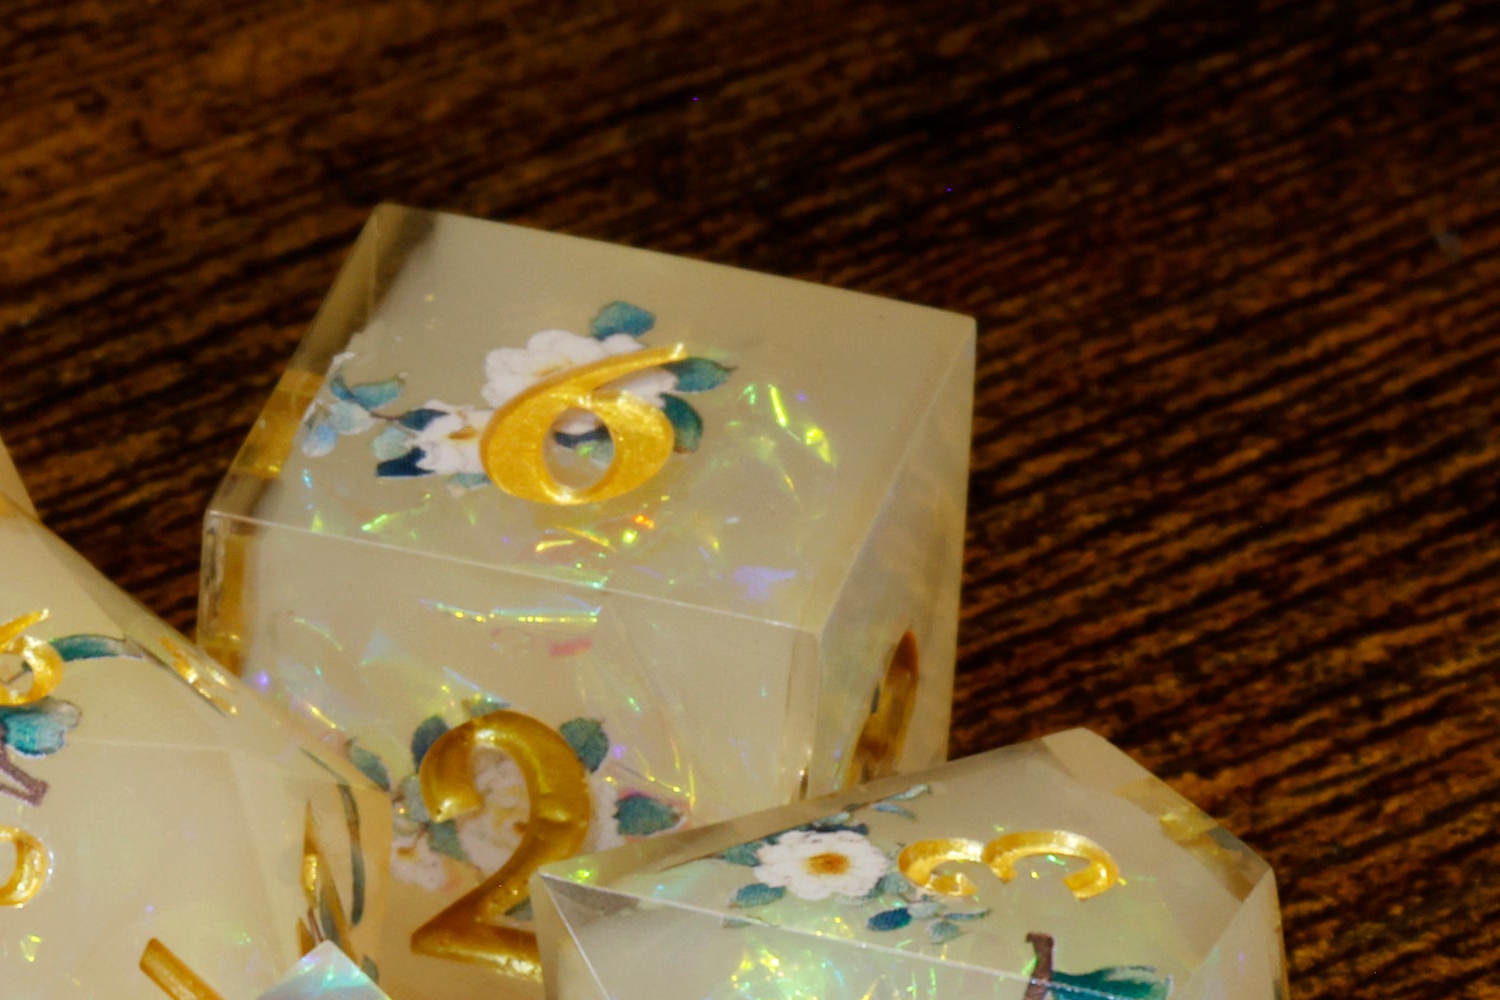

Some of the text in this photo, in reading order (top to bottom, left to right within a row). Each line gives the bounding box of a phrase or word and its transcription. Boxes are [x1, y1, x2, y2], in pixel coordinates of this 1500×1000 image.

[478, 343, 689, 506] 6
[411, 710, 591, 985] 2
[898, 830, 1120, 901] 3
